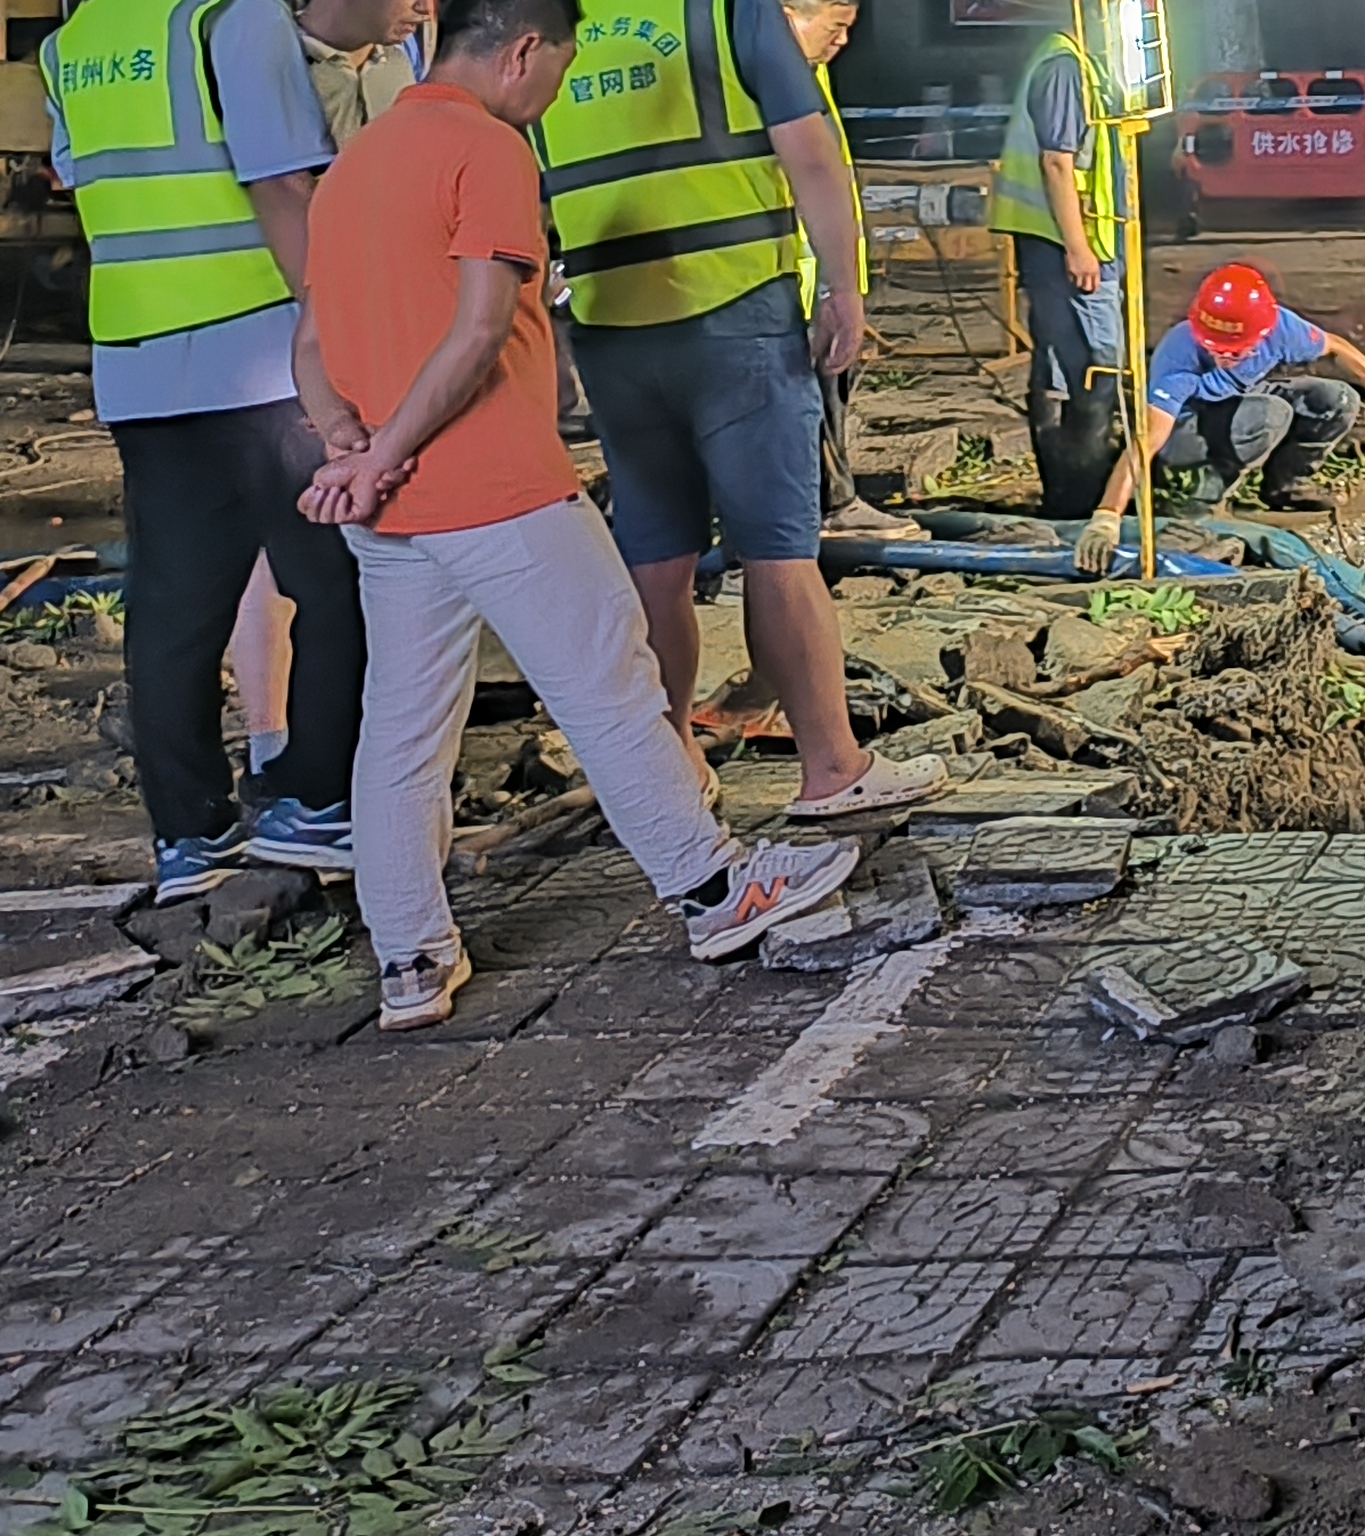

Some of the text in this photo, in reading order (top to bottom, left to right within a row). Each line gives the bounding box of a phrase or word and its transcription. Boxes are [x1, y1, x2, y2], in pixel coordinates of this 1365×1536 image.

[576, 17, 682, 57] 水务集团
[570, 62, 657, 103] 管网部
[1251, 129, 1356, 156] 供水抢修
